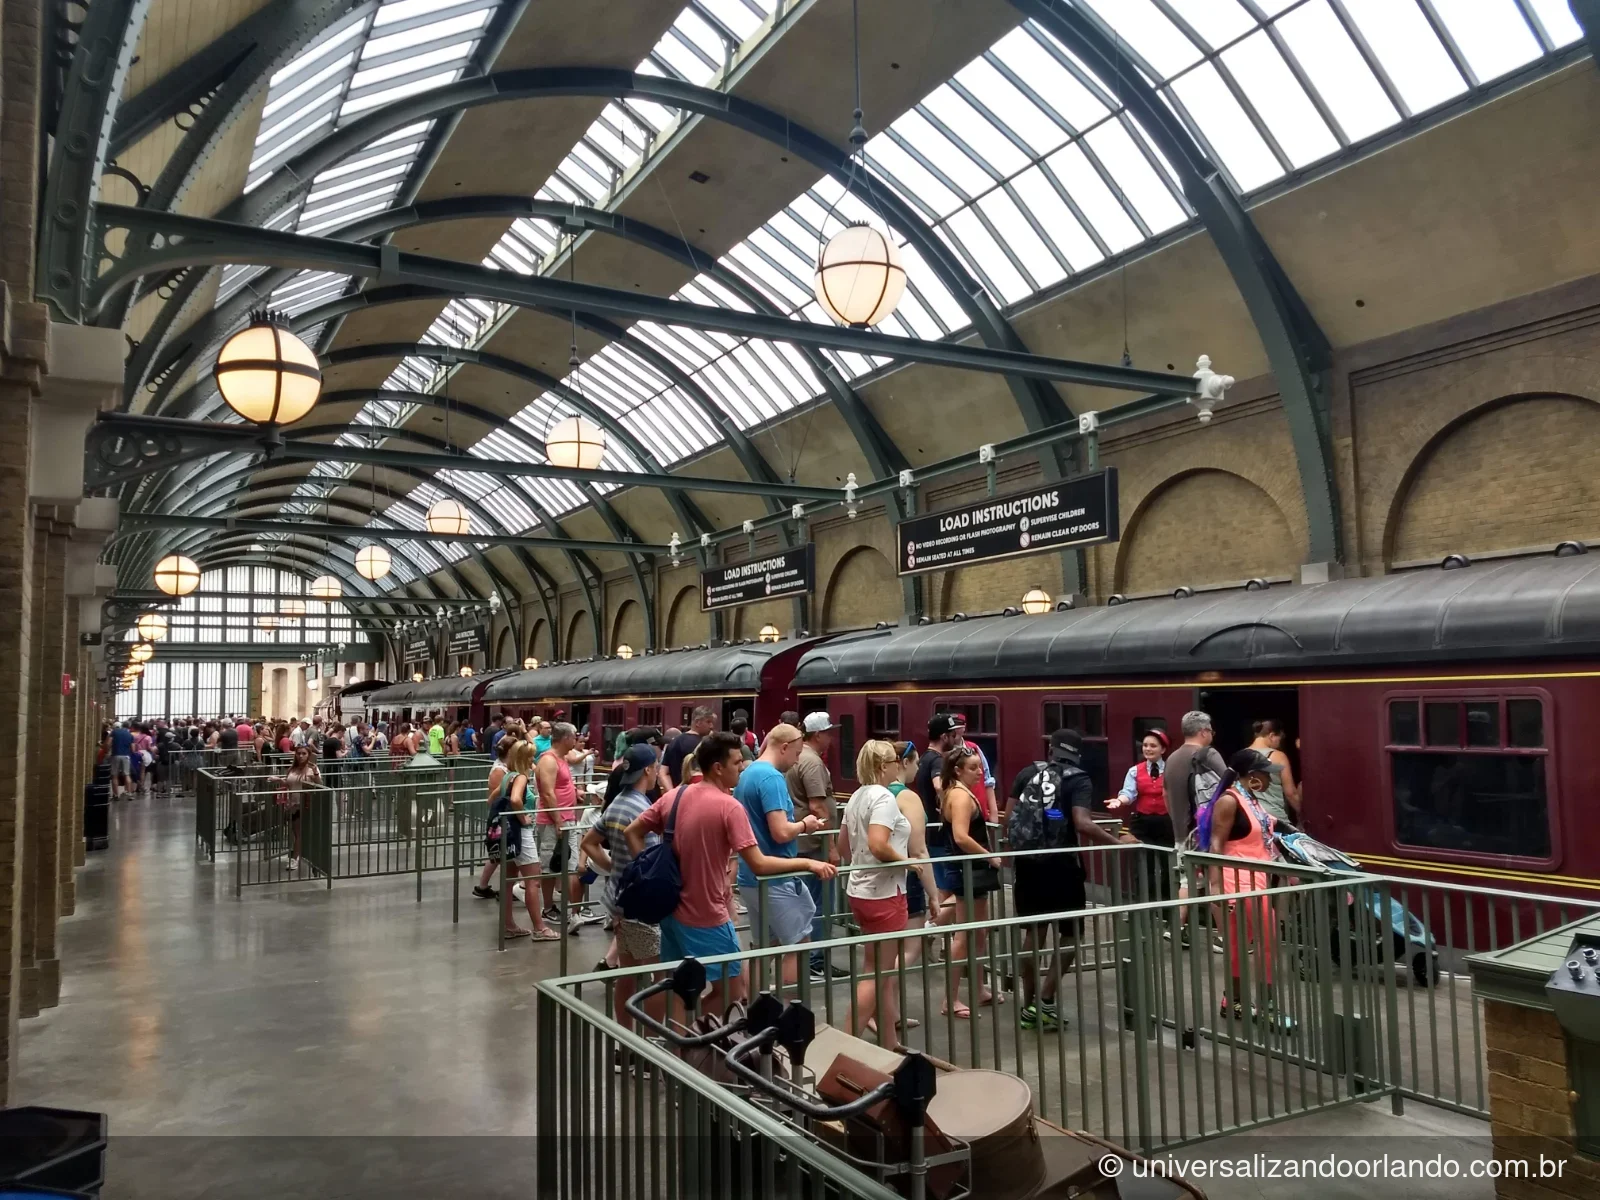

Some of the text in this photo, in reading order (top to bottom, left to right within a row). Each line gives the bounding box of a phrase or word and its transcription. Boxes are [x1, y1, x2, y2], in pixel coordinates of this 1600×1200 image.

[940, 491, 1059, 532] LOAD INSTRUCTIONS
[1030, 507, 1086, 526] SUPERVISE CHILDREN
[923, 540, 935, 549] VIDEO
[936, 535, 958, 546] RECORDING
[959, 533, 966, 541] OR
[966, 530, 980, 539] FLASH
[980, 523, 1016, 537] PHOTOGRAPHY
[1031, 521, 1100, 542] REMAIN CLEAR OF DOORS
[916, 555, 931, 564] REMAIN
[931, 552, 946, 561] SEATED
[953, 549, 961, 557] ALL
[961, 547, 975, 555] TIMES
[724, 567, 740, 580] LOAD
[741, 556, 785, 577] INSTRUCTIONS
